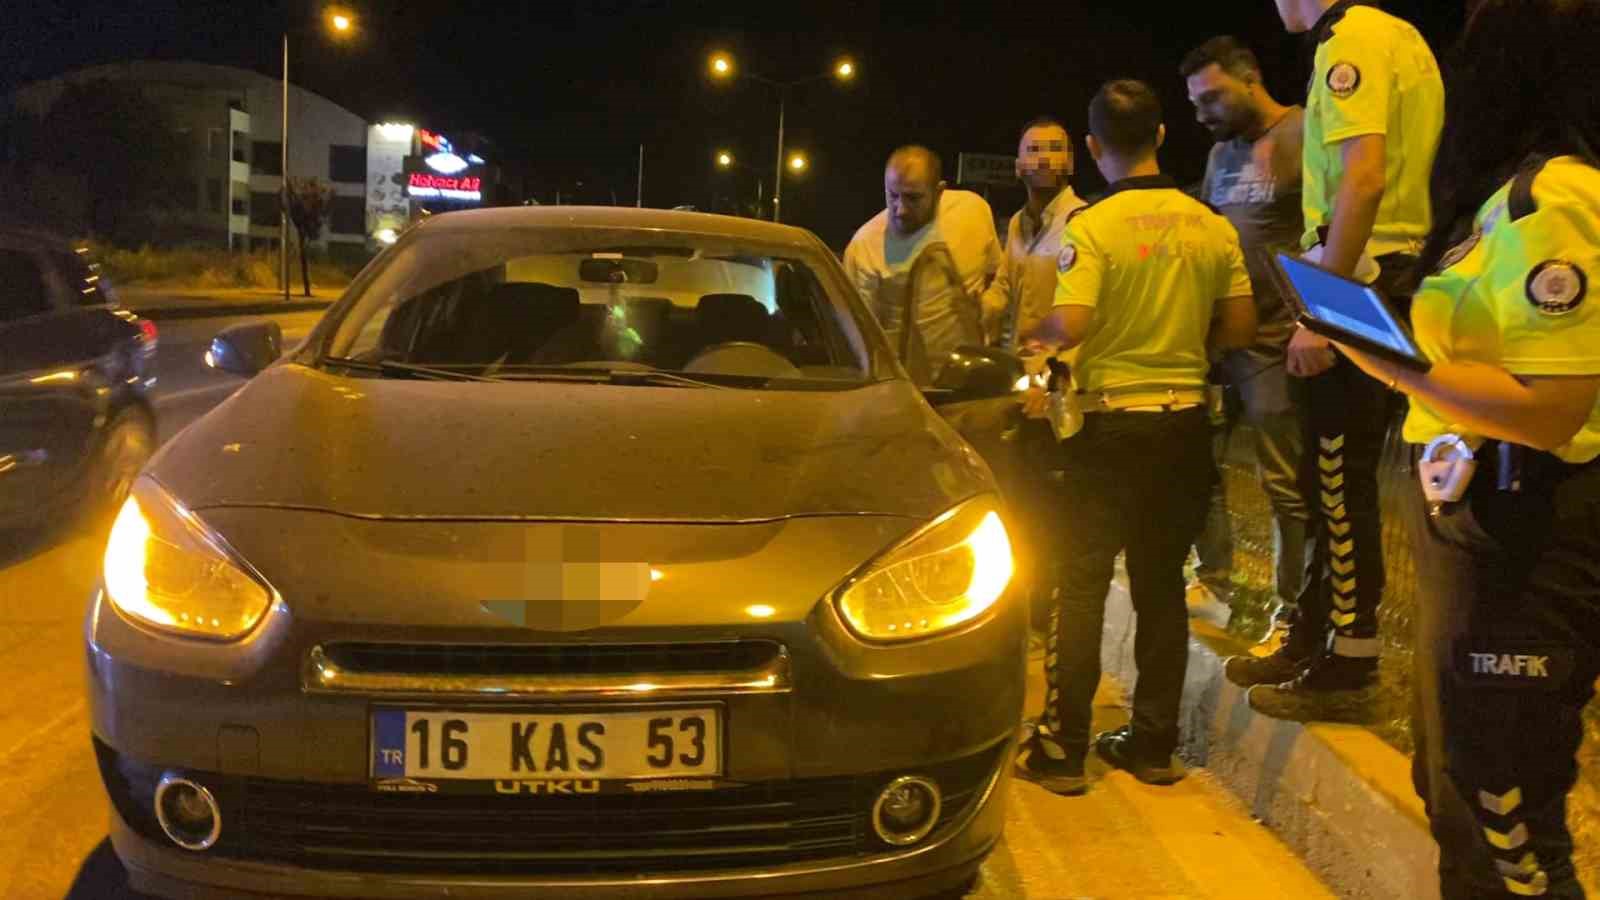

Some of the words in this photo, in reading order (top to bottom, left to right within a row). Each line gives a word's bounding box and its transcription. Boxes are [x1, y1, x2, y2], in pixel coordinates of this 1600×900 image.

[411, 718, 468, 770] 16
[511, 721, 606, 772] KAS
[647, 716, 706, 768] 53
[380, 748, 403, 765] TR
[494, 779, 600, 794] UTKU
